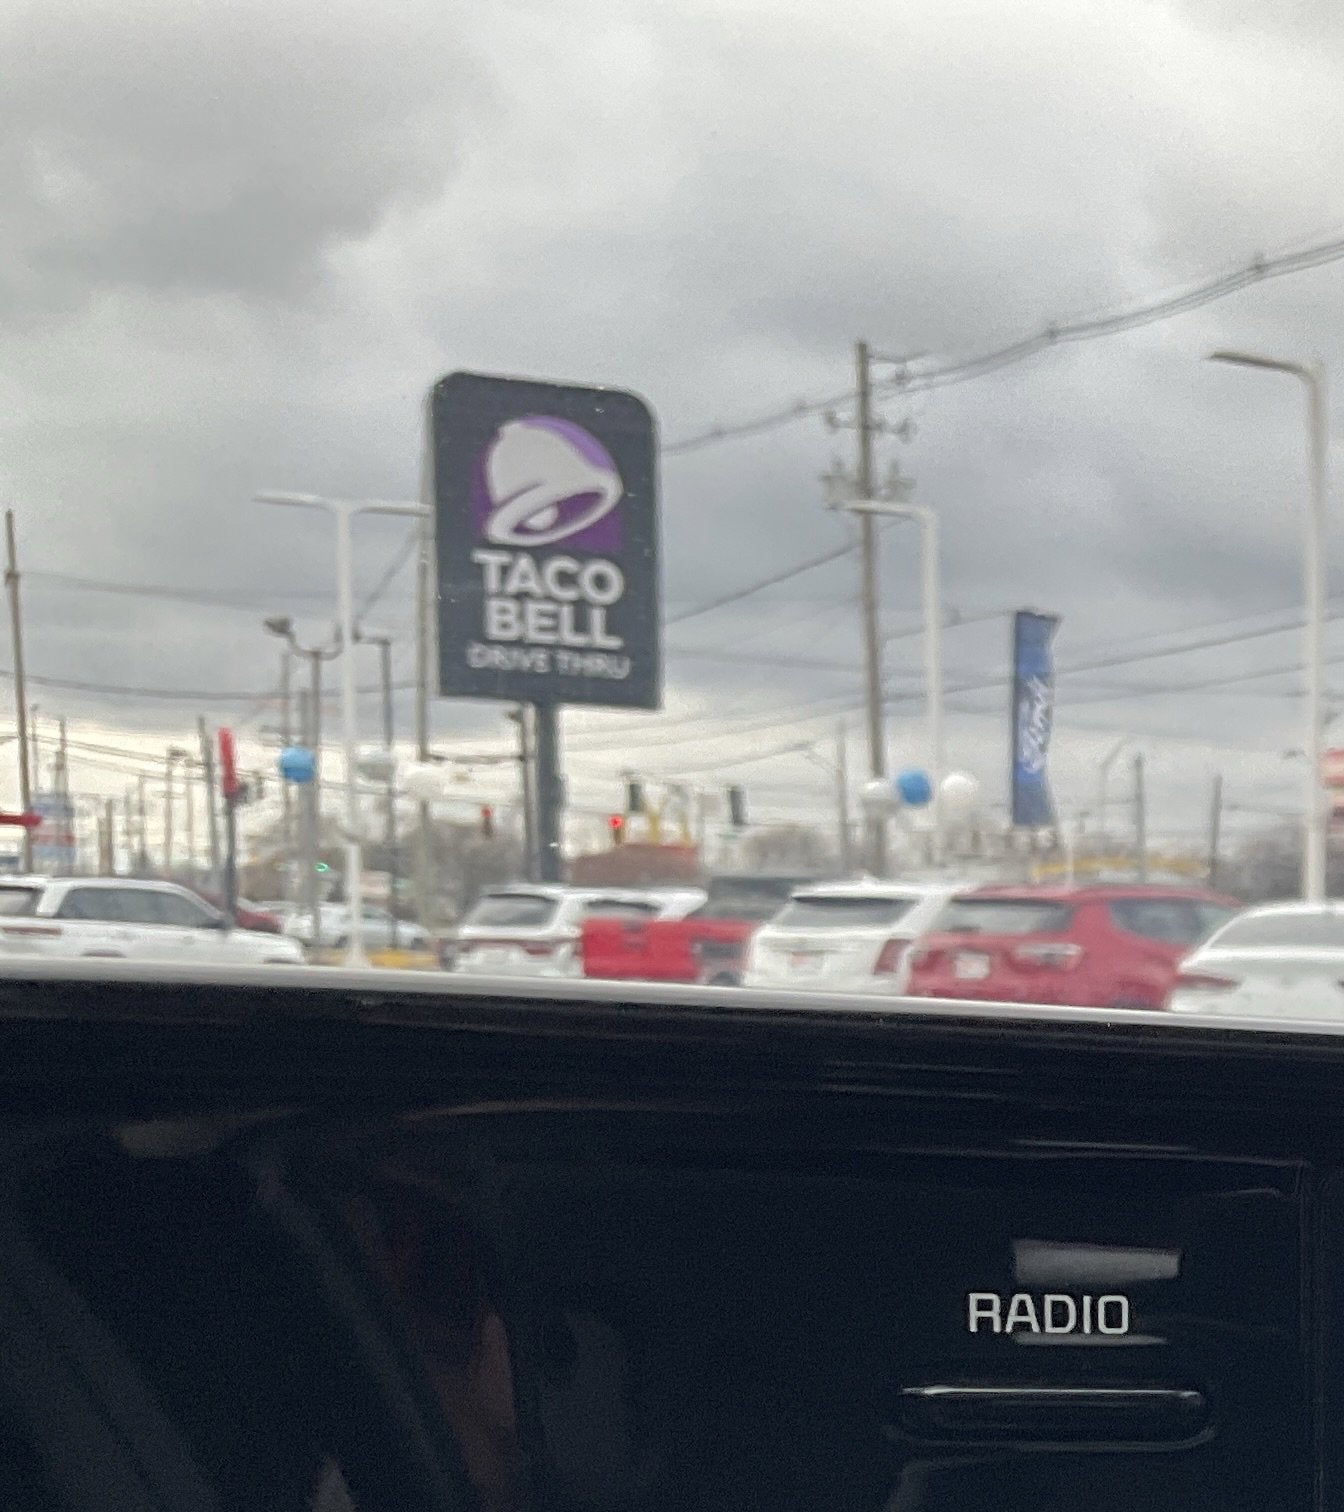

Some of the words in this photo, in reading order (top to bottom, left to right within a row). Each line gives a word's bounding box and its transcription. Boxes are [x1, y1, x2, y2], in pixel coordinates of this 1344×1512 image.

[470, 549, 624, 604] TACO
[485, 597, 624, 650] BELL
[968, 1292, 1129, 1335] RADIO
